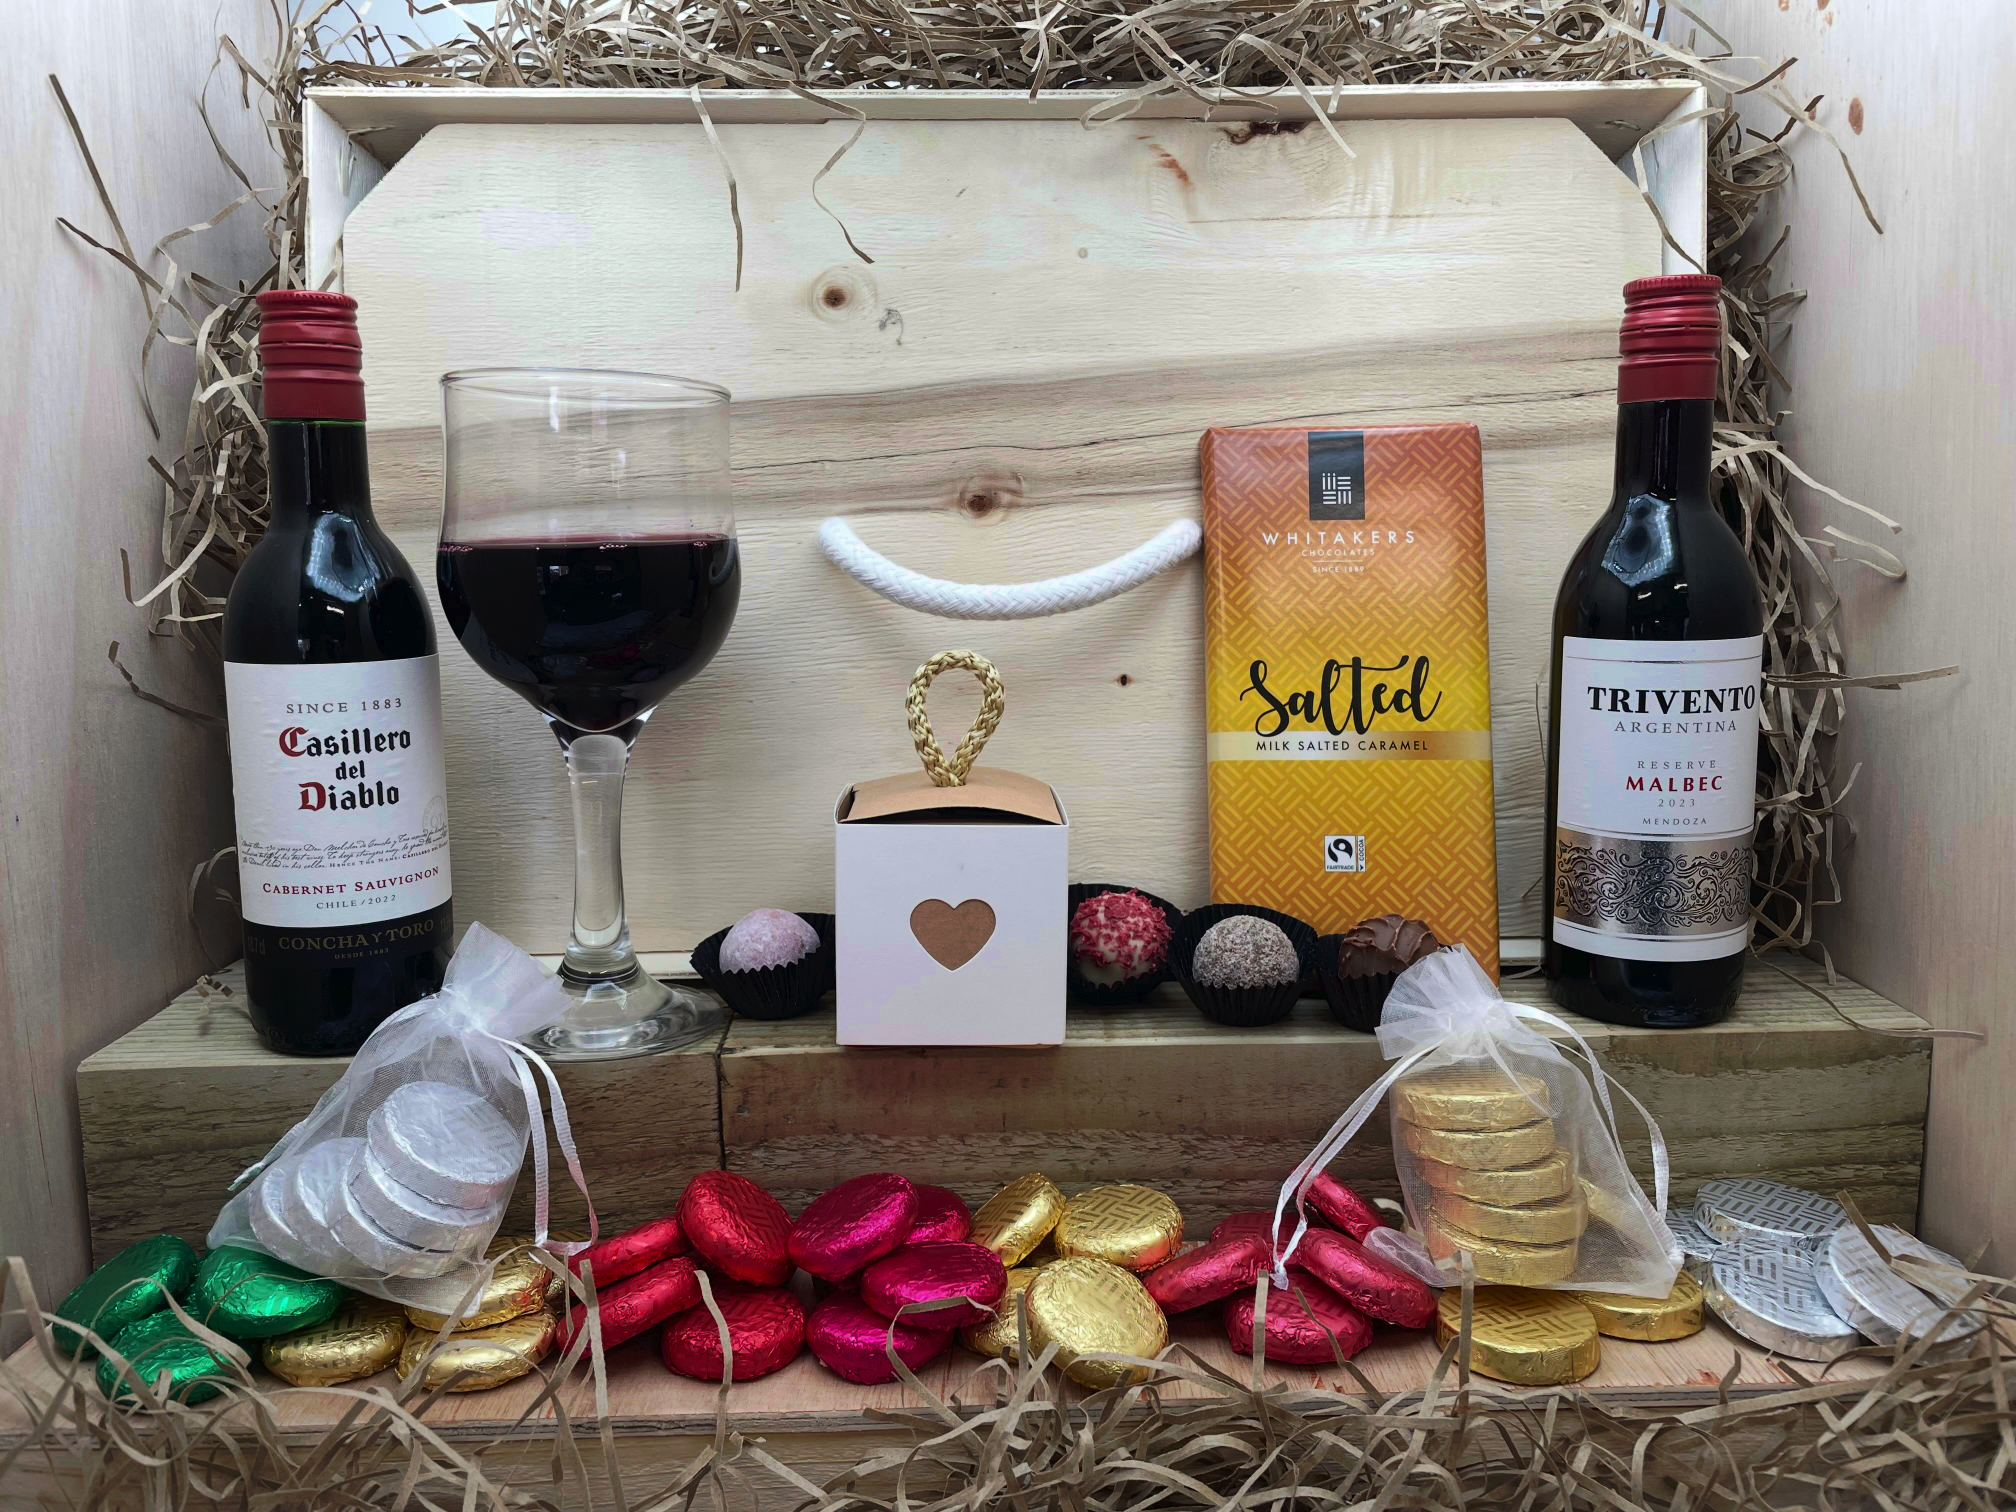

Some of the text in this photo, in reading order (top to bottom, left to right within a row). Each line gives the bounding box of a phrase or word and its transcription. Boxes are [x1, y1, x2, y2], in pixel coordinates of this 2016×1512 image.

[1262, 530, 1415, 545] WHITAKERS
[1301, 548, 1375, 557] CHOCOLATES
[1343, 565, 1365, 573] 1889
[1240, 655, 1443, 738] Salted
[1587, 684, 1756, 715] TRIVENTO
[286, 697, 402, 715] SINCE 1883
[1614, 720, 1737, 734] ARGENTINA
[278, 726, 411, 757] Casillero
[1256, 740, 1429, 751] MILK SALTED CARAMEL
[335, 760, 365, 781] del
[1637, 759, 1717, 770] RESERVE
[1626, 775, 1723, 792] MALBEC
[297, 780, 399, 812] Diablo
[1658, 798, 1696, 808] 2023
[1642, 817, 1708, 826] MENDOZA
[262, 866, 440, 895] CABERNET SAUVIGNON
[278, 934, 370, 950] CONCHA
[372, 932, 383, 943] Y
[385, 919, 434, 942] TORO
[334, 951, 365, 960] DESDE
